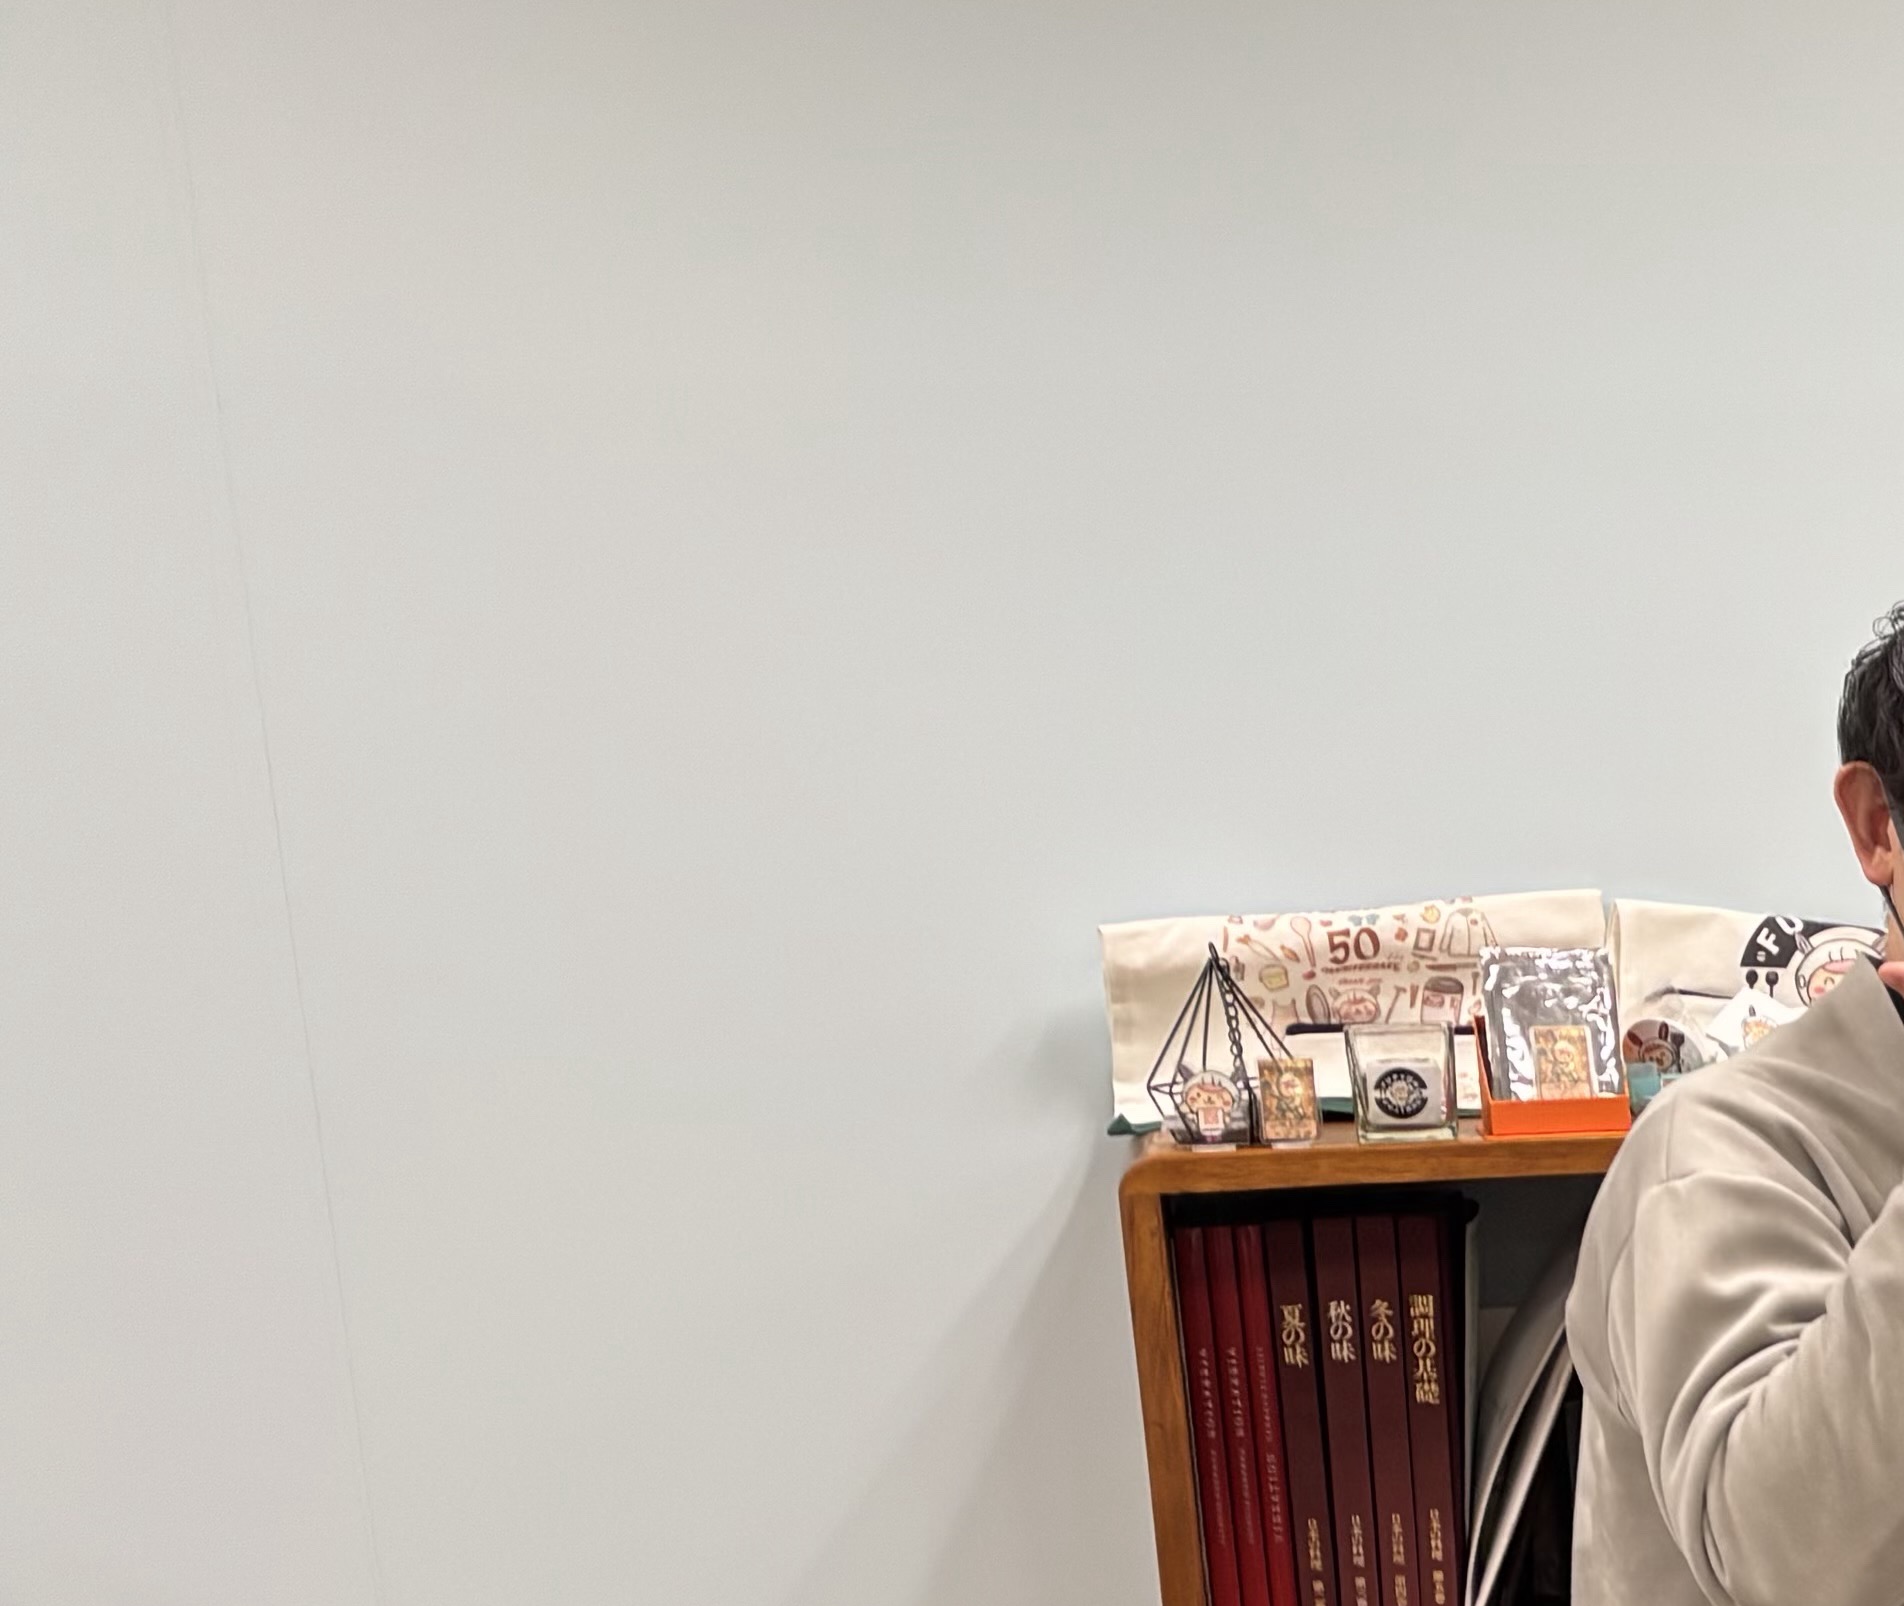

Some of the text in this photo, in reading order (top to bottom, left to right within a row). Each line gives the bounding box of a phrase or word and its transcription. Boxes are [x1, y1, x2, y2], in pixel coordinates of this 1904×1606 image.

[1326, 926, 1381, 966] 50
[1278, 1302, 1310, 1369] 夏の味
[1327, 1299, 1357, 1365] 秋の味
[1369, 1298, 1398, 1365] 冬の味
